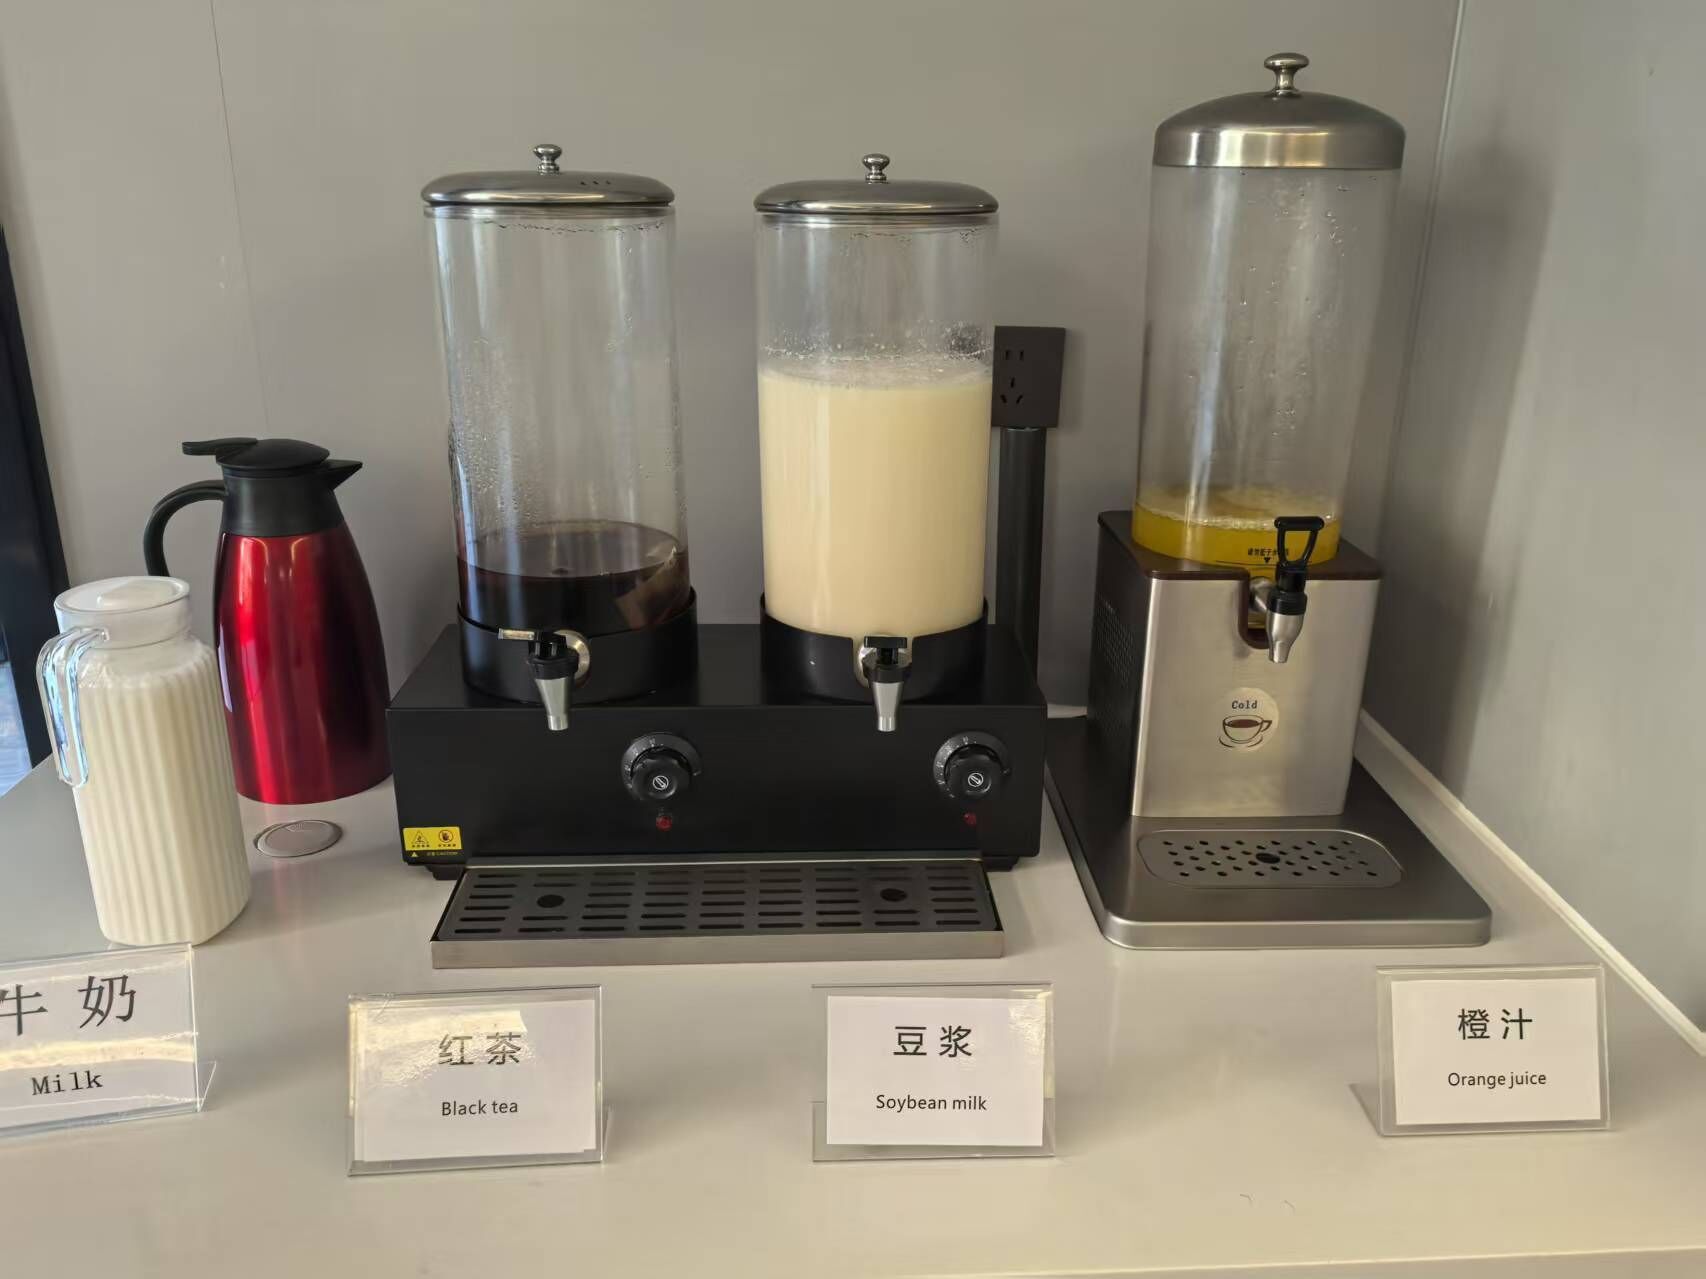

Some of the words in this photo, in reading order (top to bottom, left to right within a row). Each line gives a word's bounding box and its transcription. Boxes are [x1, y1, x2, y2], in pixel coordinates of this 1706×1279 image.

[1231, 700, 1258, 710] Cold
[0, 975, 136, 1036] 牛奶
[1458, 1008, 1533, 1040] 橙汁
[438, 1032, 522, 1066] 红茶
[893, 1025, 972, 1058] 豆浆
[31, 1070, 103, 1096] Milk
[1447, 1073, 1506, 1090] Orange
[1508, 1072, 1546, 1090] juice
[441, 1100, 487, 1116] Black
[491, 1101, 518, 1115] tea
[876, 1094, 947, 1113] Soybean
[952, 1095, 987, 1110] milk
